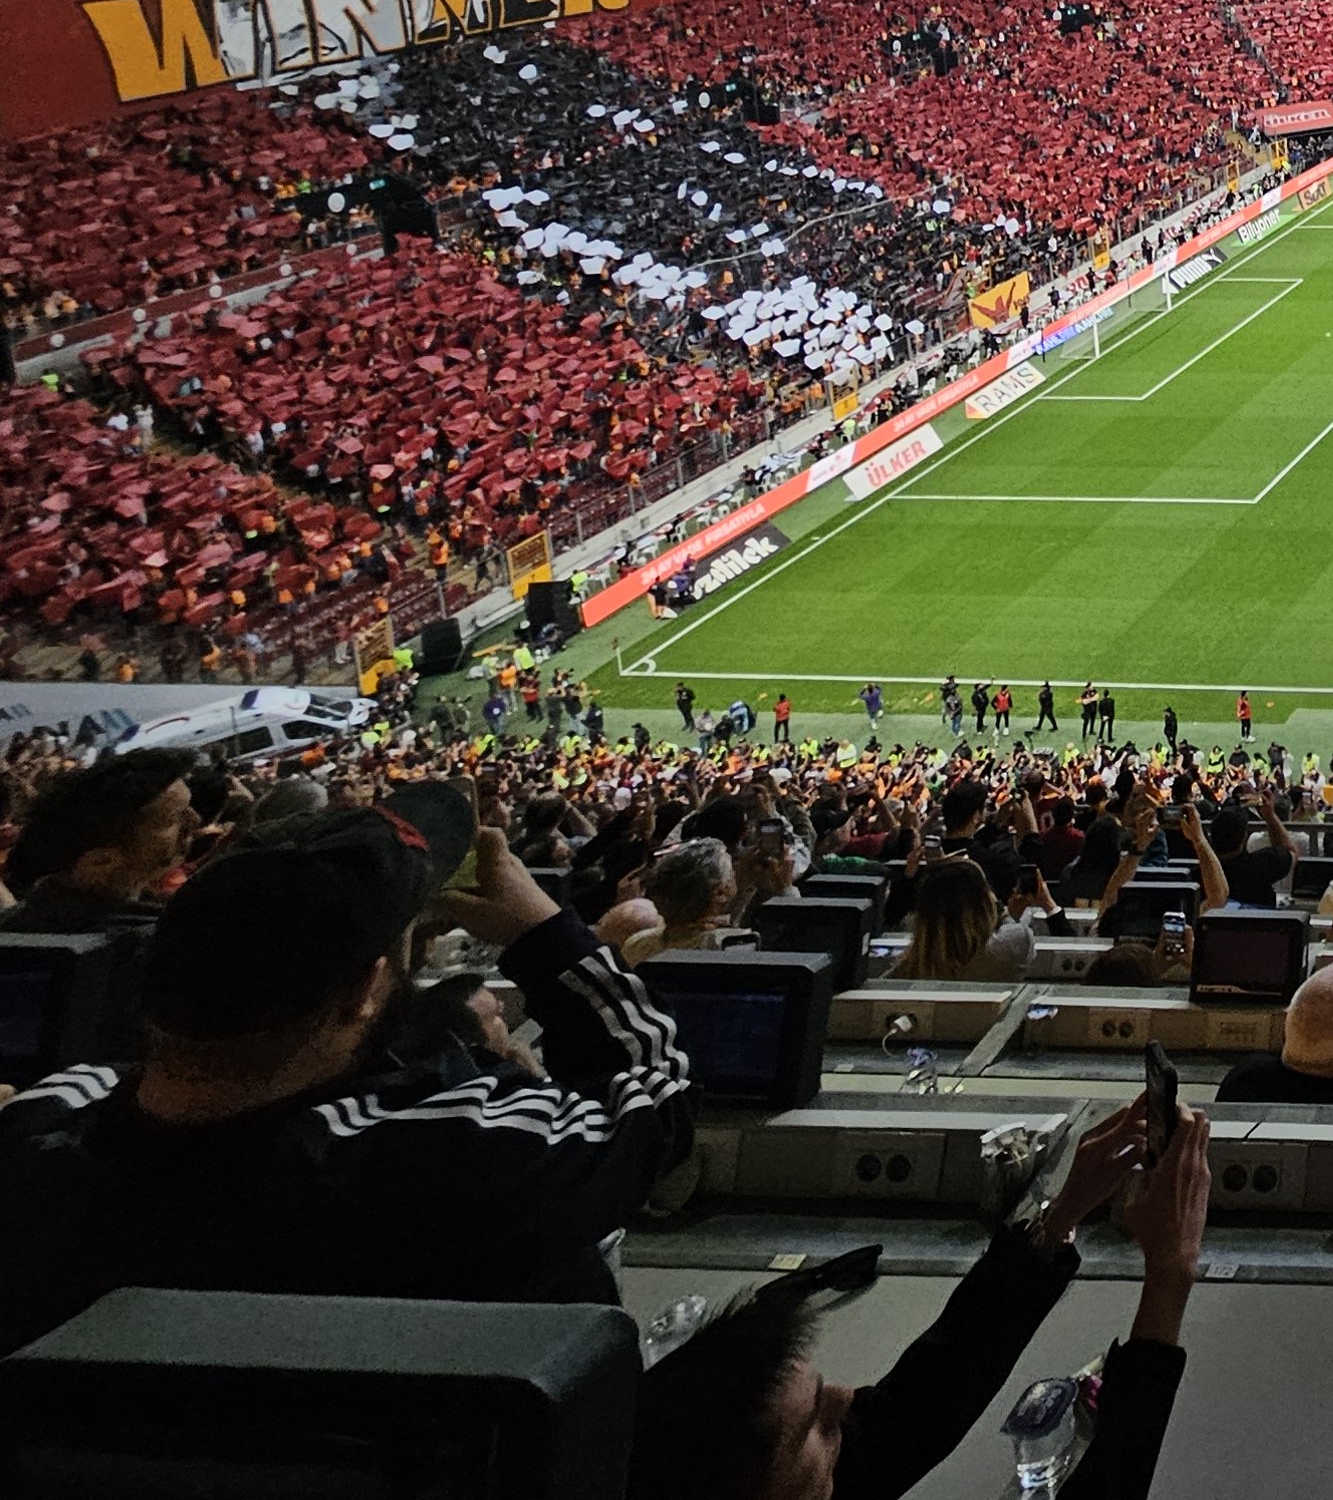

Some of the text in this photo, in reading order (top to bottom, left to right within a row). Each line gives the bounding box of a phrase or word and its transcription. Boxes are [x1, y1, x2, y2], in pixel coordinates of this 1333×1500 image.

[1239, 208, 1281, 243] Bilyoner
[974, 366, 1036, 414] RAMS
[867, 438, 927, 488] ÜLKER
